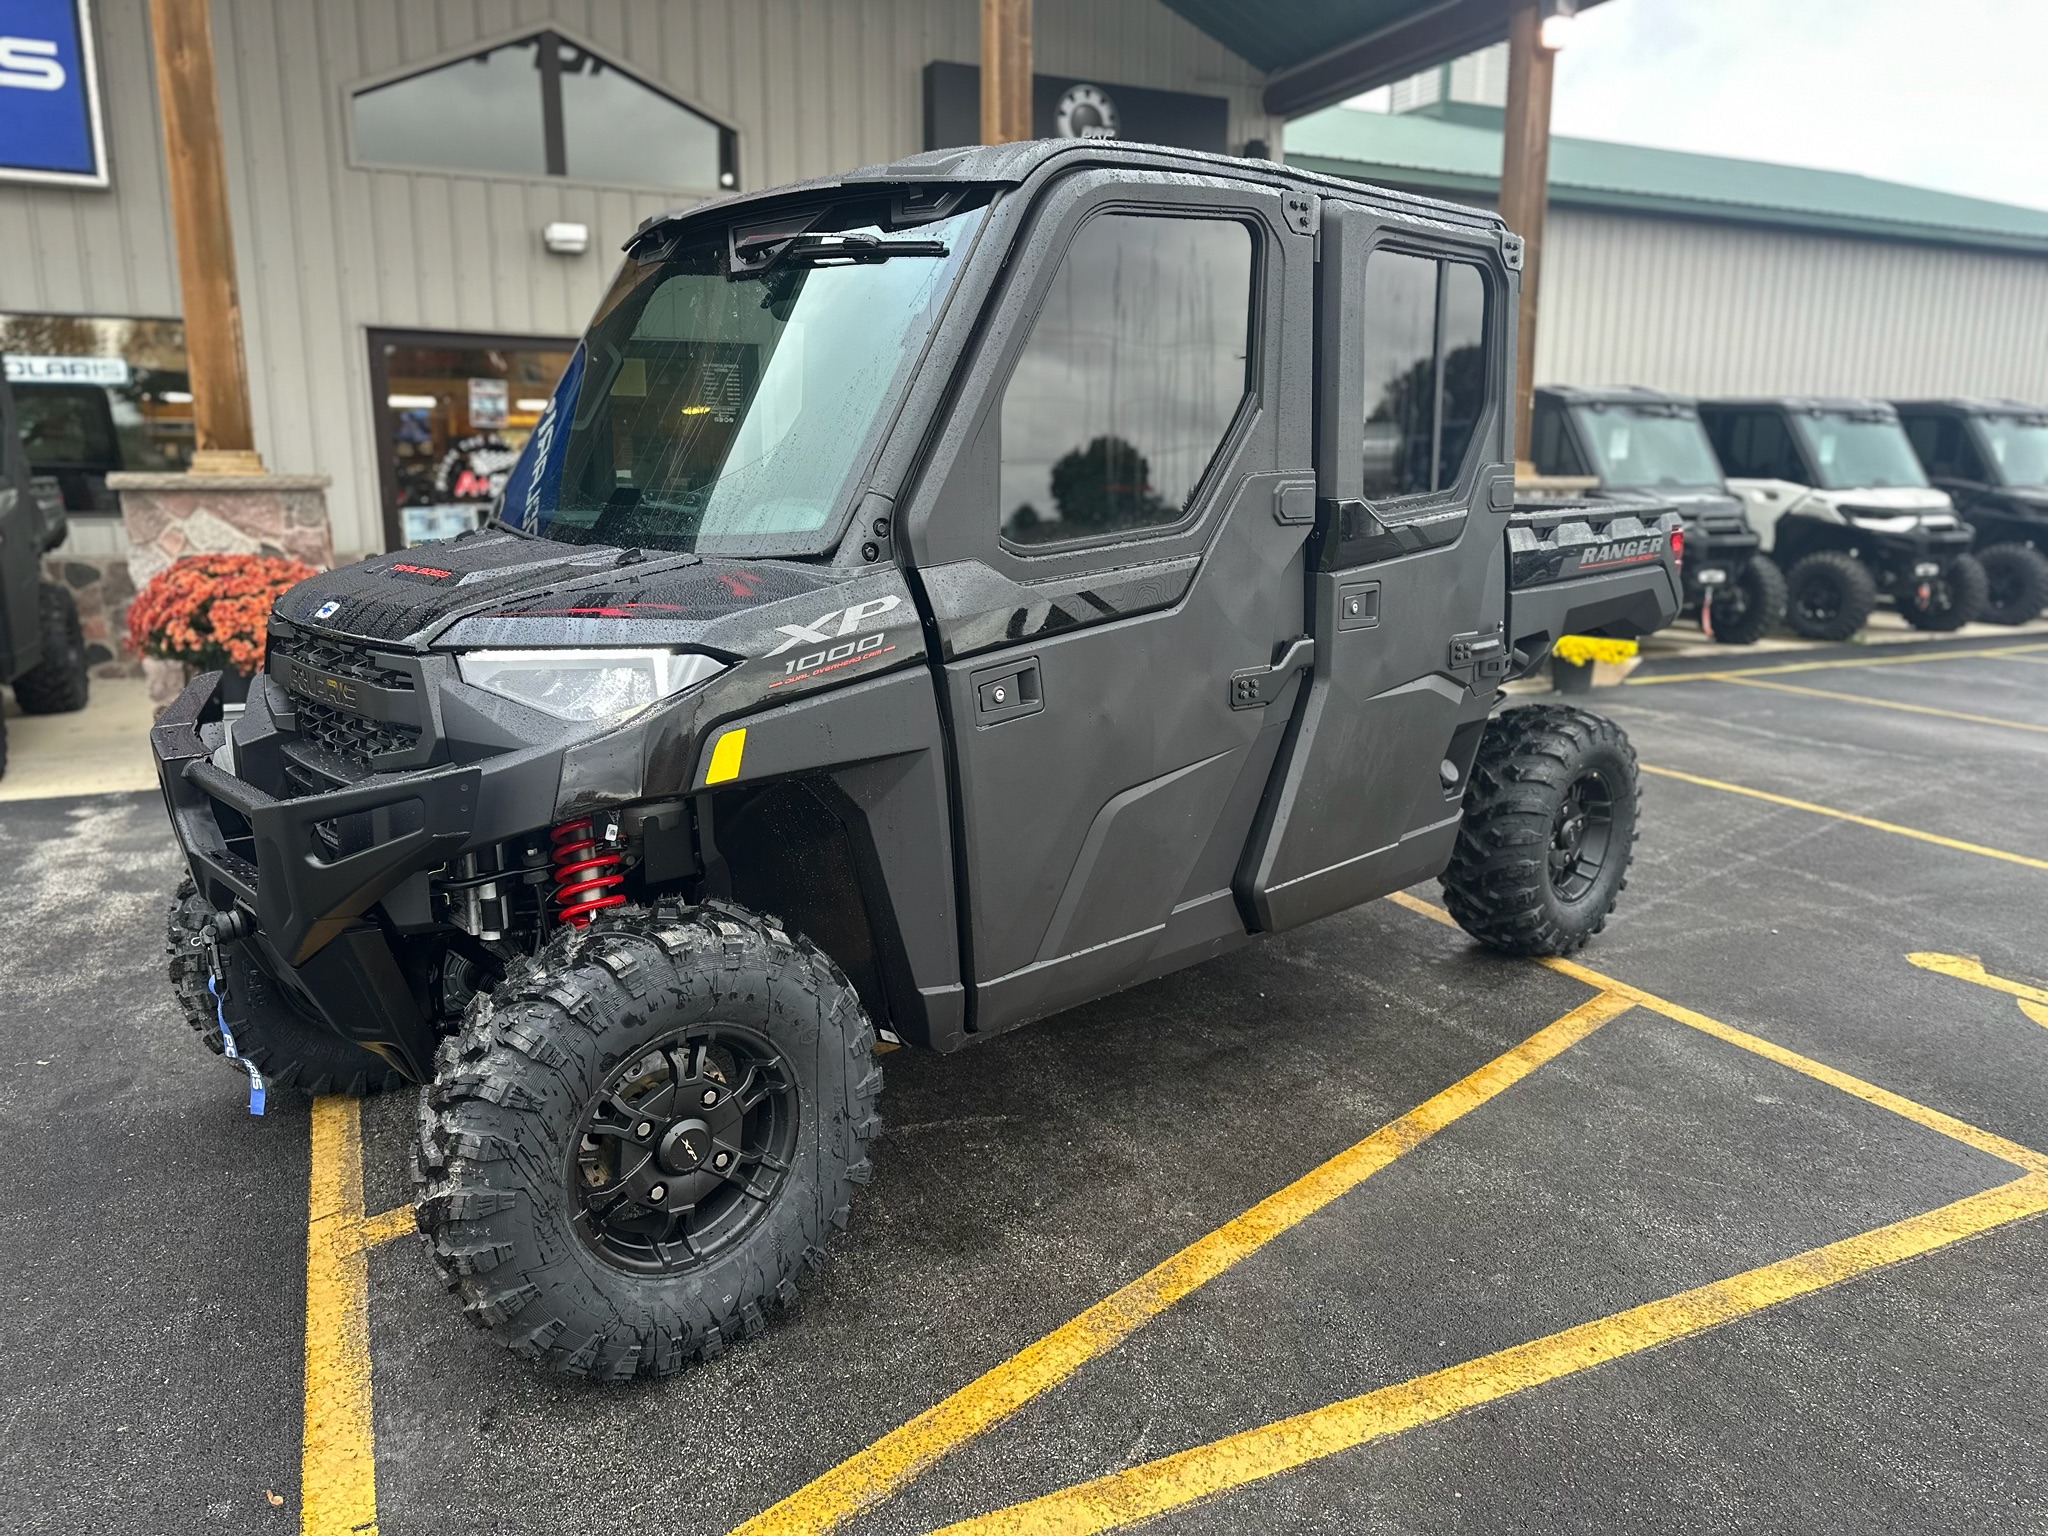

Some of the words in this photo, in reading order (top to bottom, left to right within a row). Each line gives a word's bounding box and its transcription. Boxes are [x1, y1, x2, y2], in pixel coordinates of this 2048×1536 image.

[1581, 538, 1663, 564] RANGER
[760, 594, 902, 660] XP
[784, 673, 811, 685] DUAL
[812, 655, 862, 676] OVERHEAD
[862, 649, 883, 660] CAM
[785, 632, 885, 676] 1000
[289, 662, 359, 710] POLARIS
[223, 1032, 264, 1091] POARIS
[680, 1138, 698, 1161] XP
